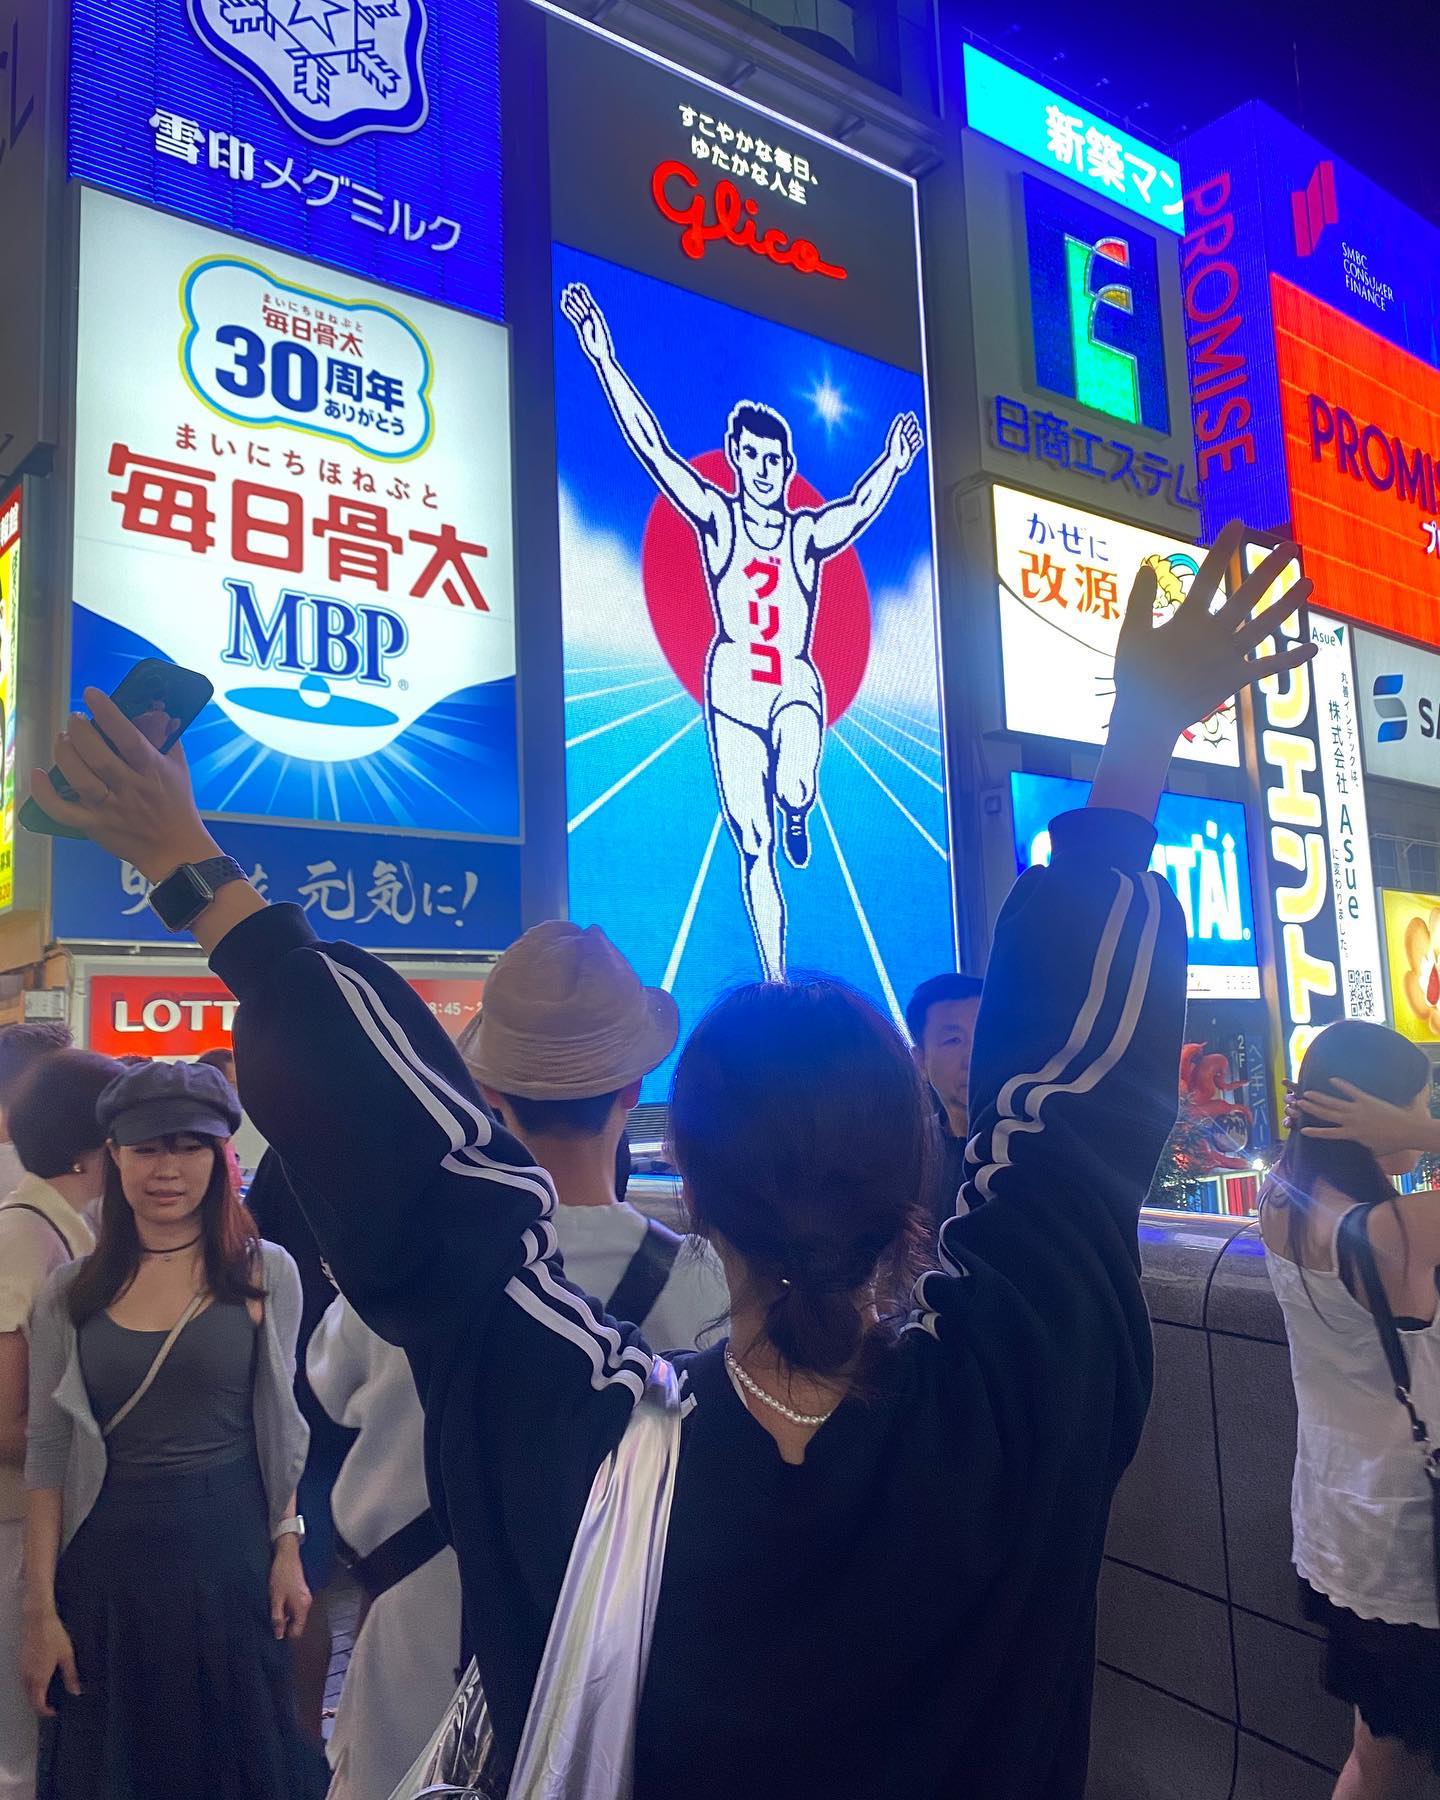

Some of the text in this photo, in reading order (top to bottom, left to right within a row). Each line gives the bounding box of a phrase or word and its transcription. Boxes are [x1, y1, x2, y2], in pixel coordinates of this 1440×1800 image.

[149, 107, 461, 251] 雪印メグミルク
[678, 103, 818, 185] すこやかな毎日、
[691, 134, 807, 205] ゆたかな人生
[1045, 105, 1184, 216] 新築マン
[652, 160, 847, 280] Glico
[1341, 241, 1368, 270] SMBC
[1343, 258, 1395, 302] CONSUMER
[262, 292, 364, 333] まいにちほねぶと
[1182, 171, 1256, 482] PROMISE
[1345, 274, 1386, 311] FINANCE
[261, 304, 364, 358] 毎日骨太
[215, 324, 405, 413] 30周年
[324, 398, 405, 436] ありがとう
[175, 423, 439, 511] まいにちほねぶと
[107, 442, 490, 612] 毎日骨太
[1027, 512, 1109, 561] かぜに
[1422, 520, 1440, 557] プ
[1018, 550, 1121, 620] 改源
[223, 577, 409, 688] MBP
[742, 555, 783, 687] グリコ
[1311, 625, 1337, 647] Asue
[1418, 697, 1440, 740] S
[1328, 699, 1359, 920] 株式会社 Asue
[1236, 1034, 1246, 1069] 2F
